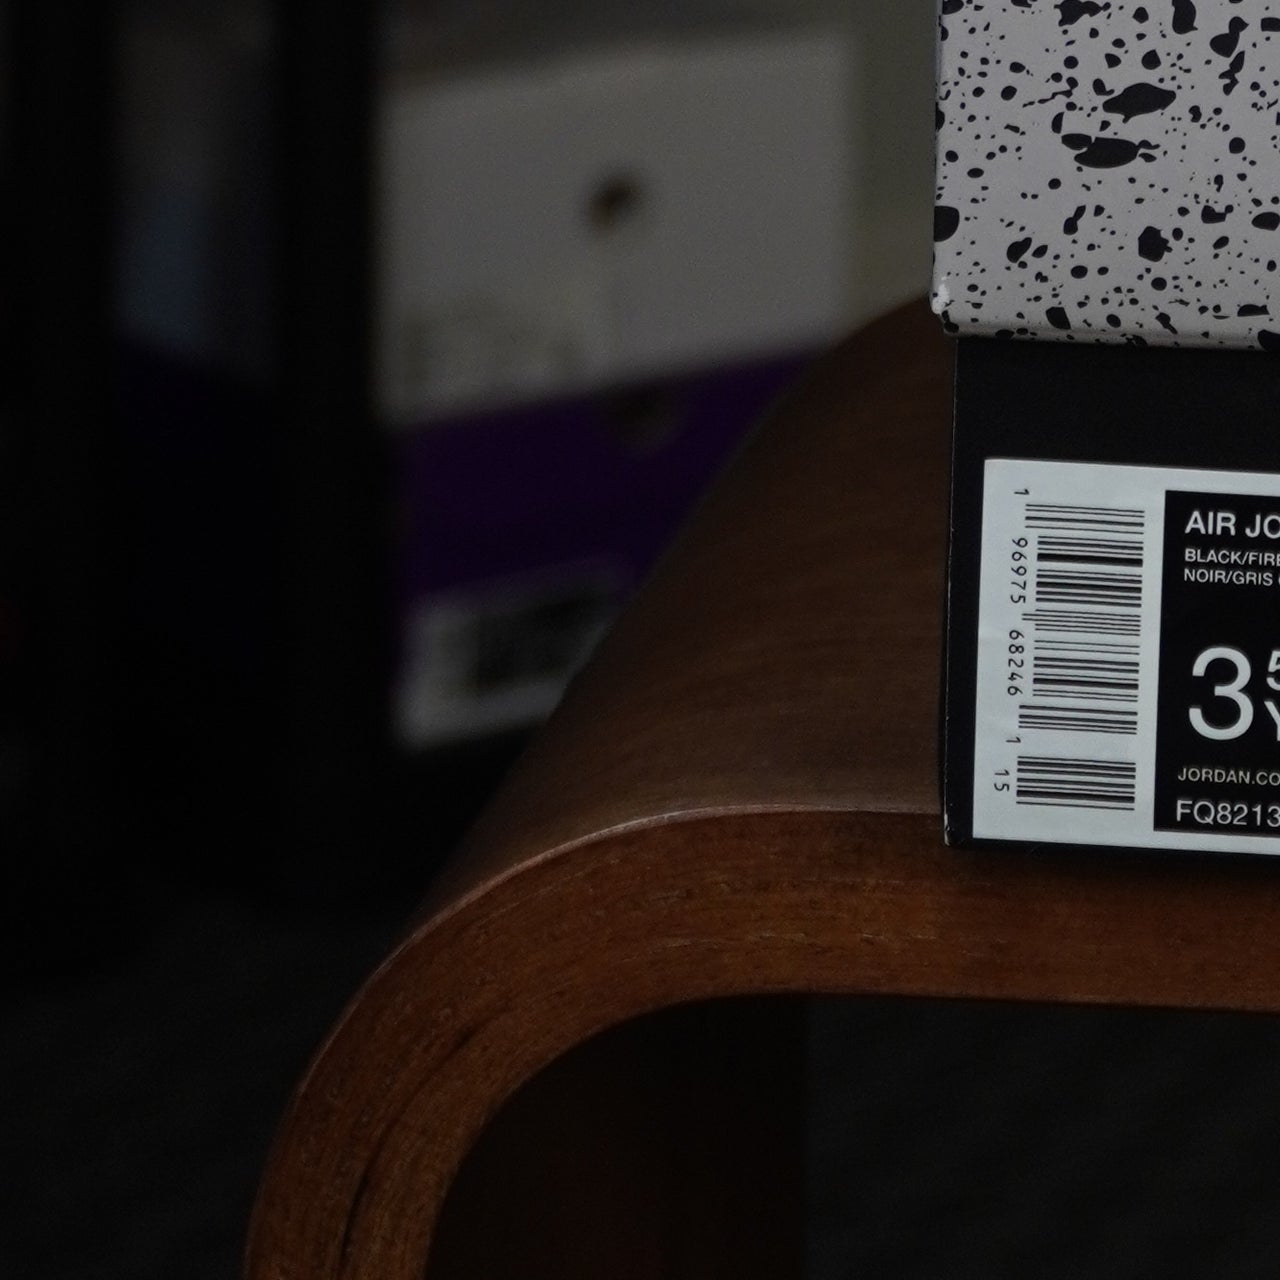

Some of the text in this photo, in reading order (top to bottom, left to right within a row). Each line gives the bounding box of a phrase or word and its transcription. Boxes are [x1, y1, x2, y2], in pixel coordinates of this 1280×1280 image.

[1184, 510, 1237, 536] AIR
[1183, 567, 1274, 587] NOIR/GRIS
[1006, 488, 1030, 744] 1 96975 68246 1
[1188, 645, 1254, 741] 3
[993, 769, 1010, 792] 15
